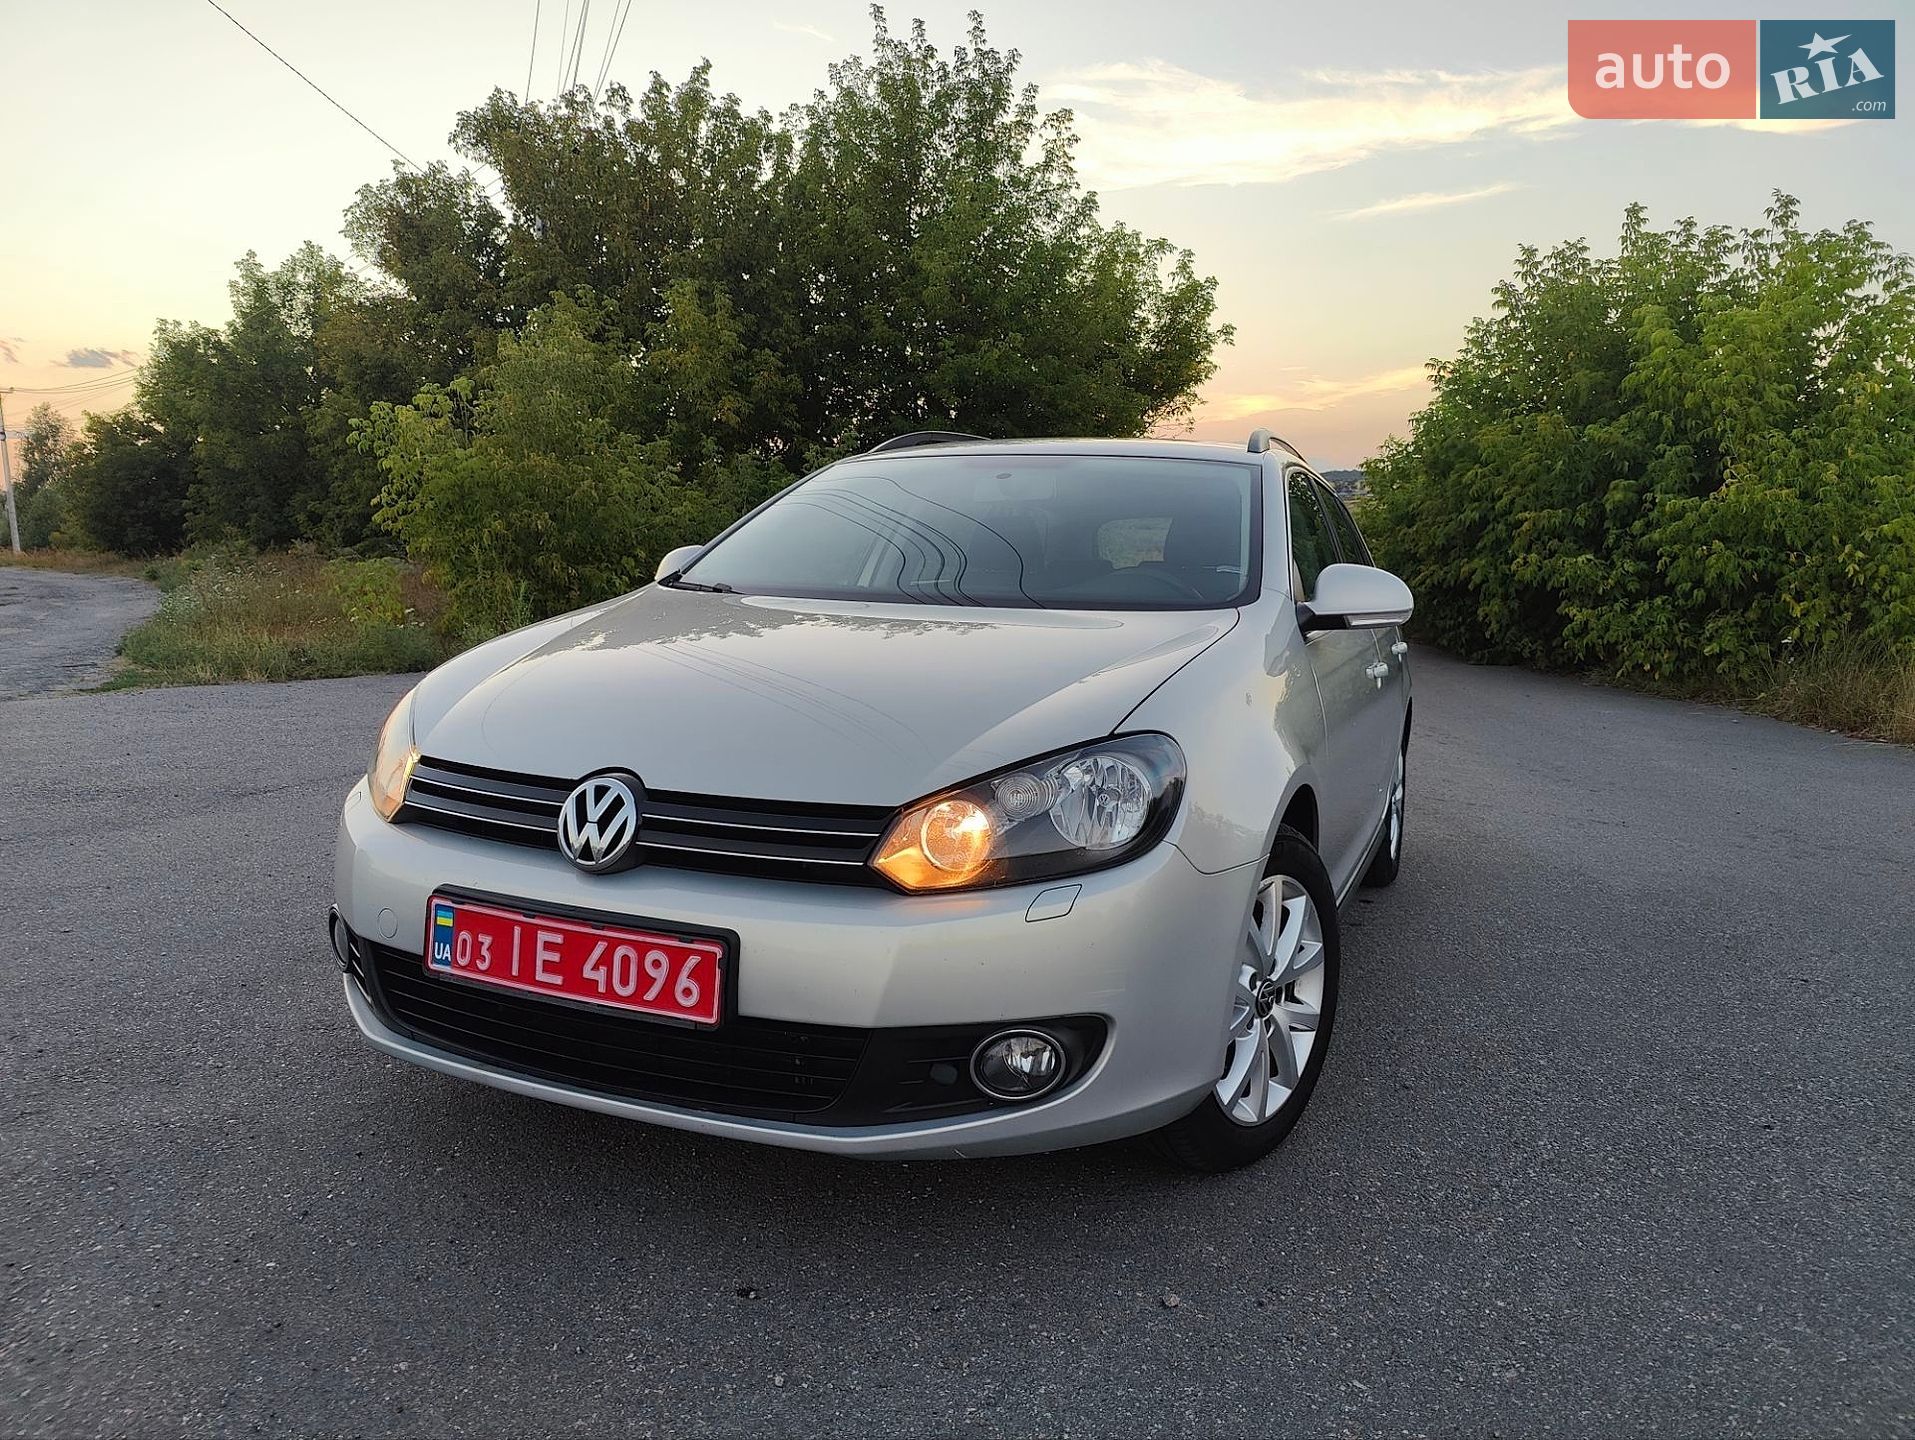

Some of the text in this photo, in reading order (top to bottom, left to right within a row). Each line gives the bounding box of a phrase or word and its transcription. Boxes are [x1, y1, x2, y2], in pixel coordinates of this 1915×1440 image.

[434, 941, 451, 962] UA
[456, 925, 701, 1008] 03 IE 4096
